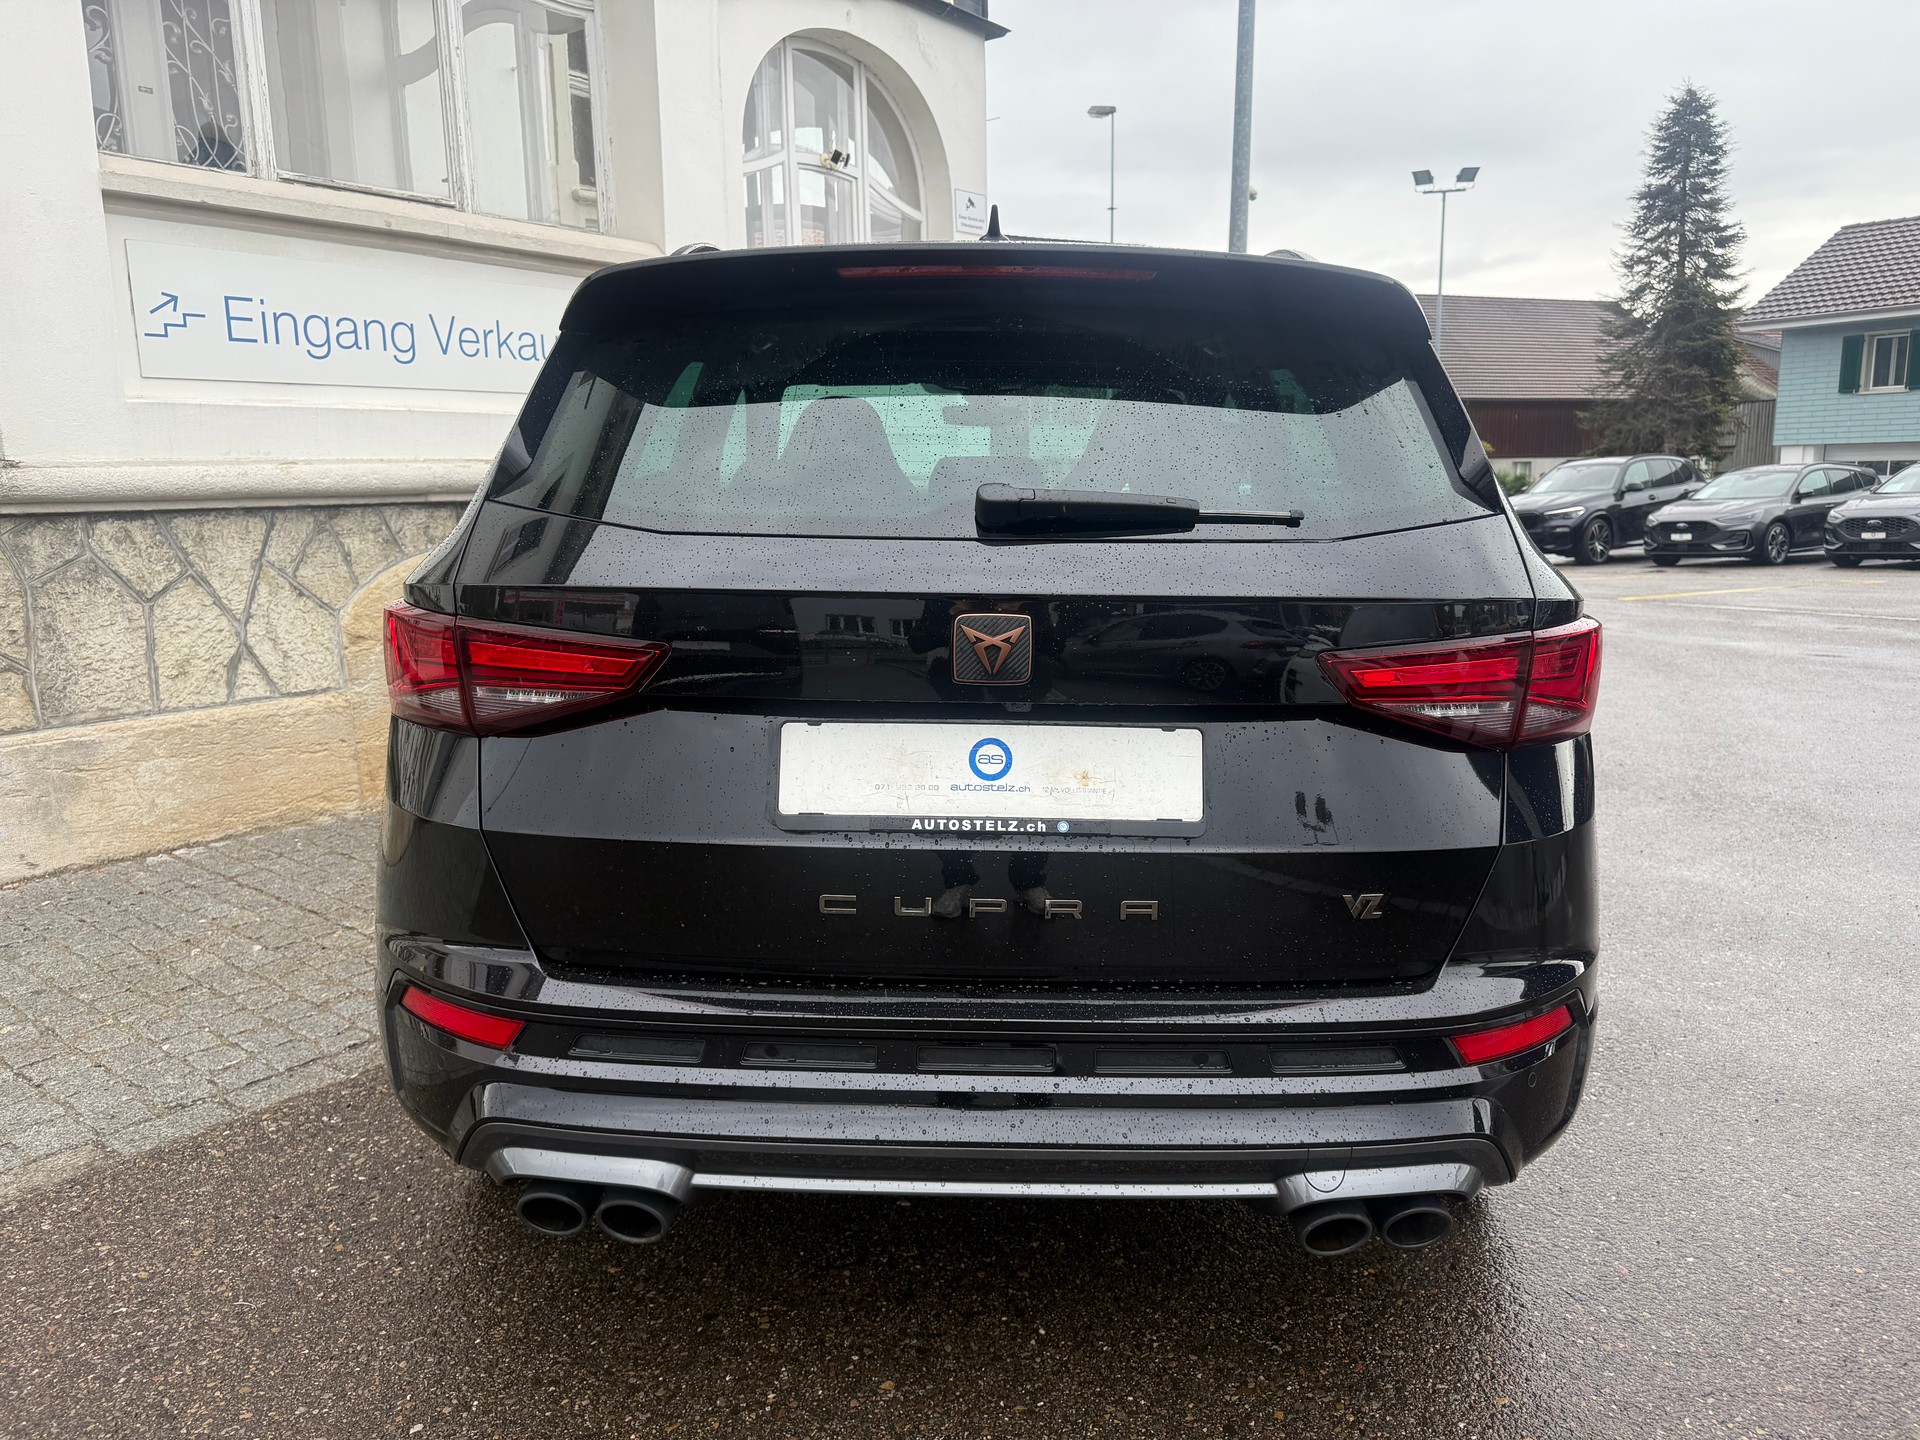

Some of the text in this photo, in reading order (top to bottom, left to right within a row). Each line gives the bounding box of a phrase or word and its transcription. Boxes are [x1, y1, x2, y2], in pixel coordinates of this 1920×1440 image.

[223, 295, 416, 365] Eingang
[977, 753, 1004, 765] as
[950, 782, 1031, 793] autostelz.ch
[911, 818, 1047, 832] AUTOSTELZ.ch
[818, 893, 1159, 921] CUPRA
[1342, 893, 1384, 920] VZ
